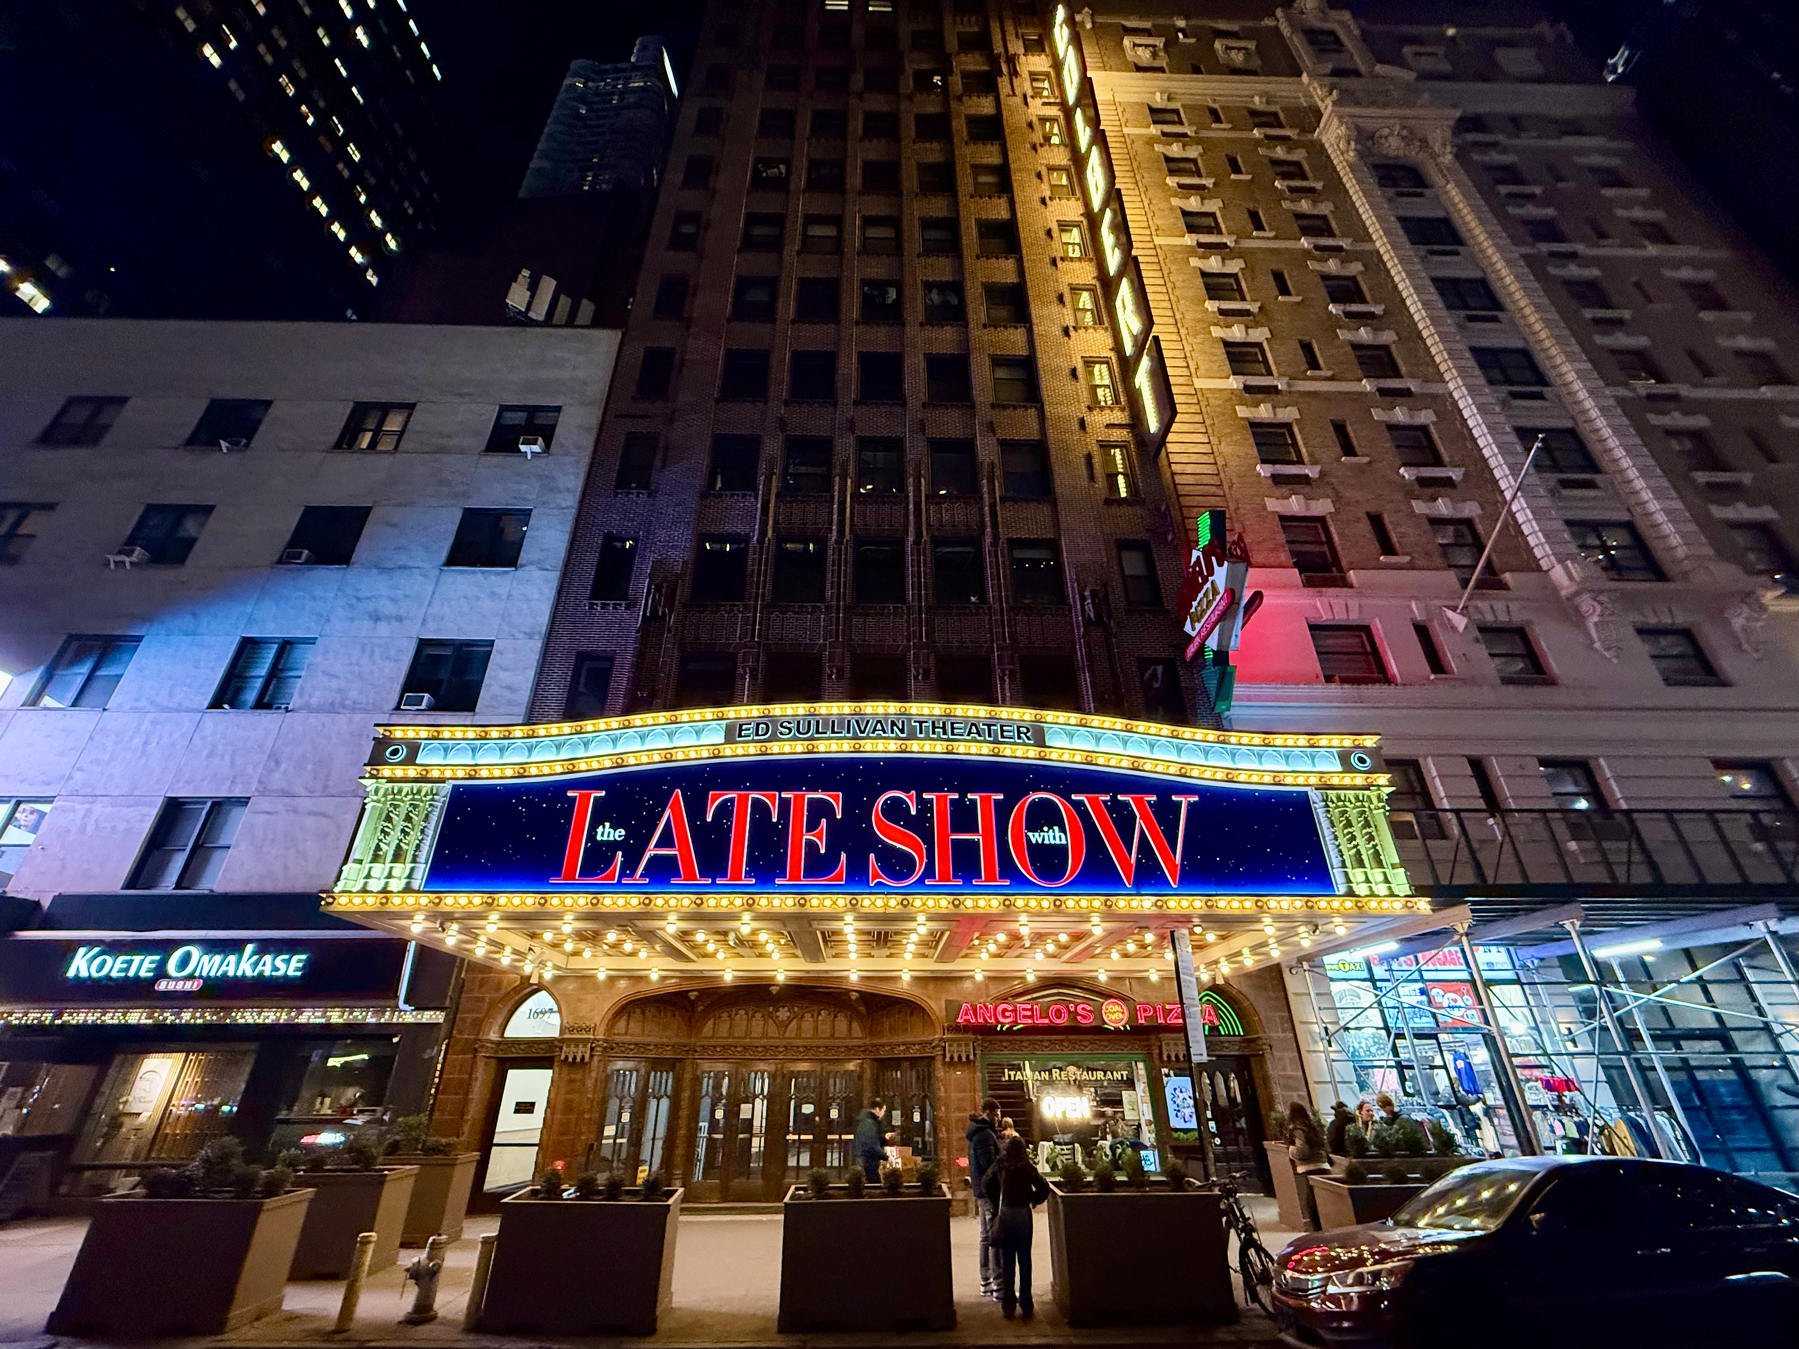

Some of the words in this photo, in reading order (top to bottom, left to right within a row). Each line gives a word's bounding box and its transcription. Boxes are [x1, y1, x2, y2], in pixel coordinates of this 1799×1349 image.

[736, 721, 772, 741] ED
[777, 718, 907, 739] SULLIVAN
[912, 719, 1035, 744] THEATER
[549, 788, 846, 884] LATE
[869, 789, 1199, 888] SHOW
[596, 822, 626, 841] the
[1026, 826, 1067, 845] with
[526, 1007, 554, 1020] 1697
[957, 1002, 1095, 1026] ANGELO'S
[1136, 1003, 1220, 1026] PIZA
[1052, 1068, 1129, 1082] RESTAURANT
[1042, 1096, 1090, 1119] OPEN
